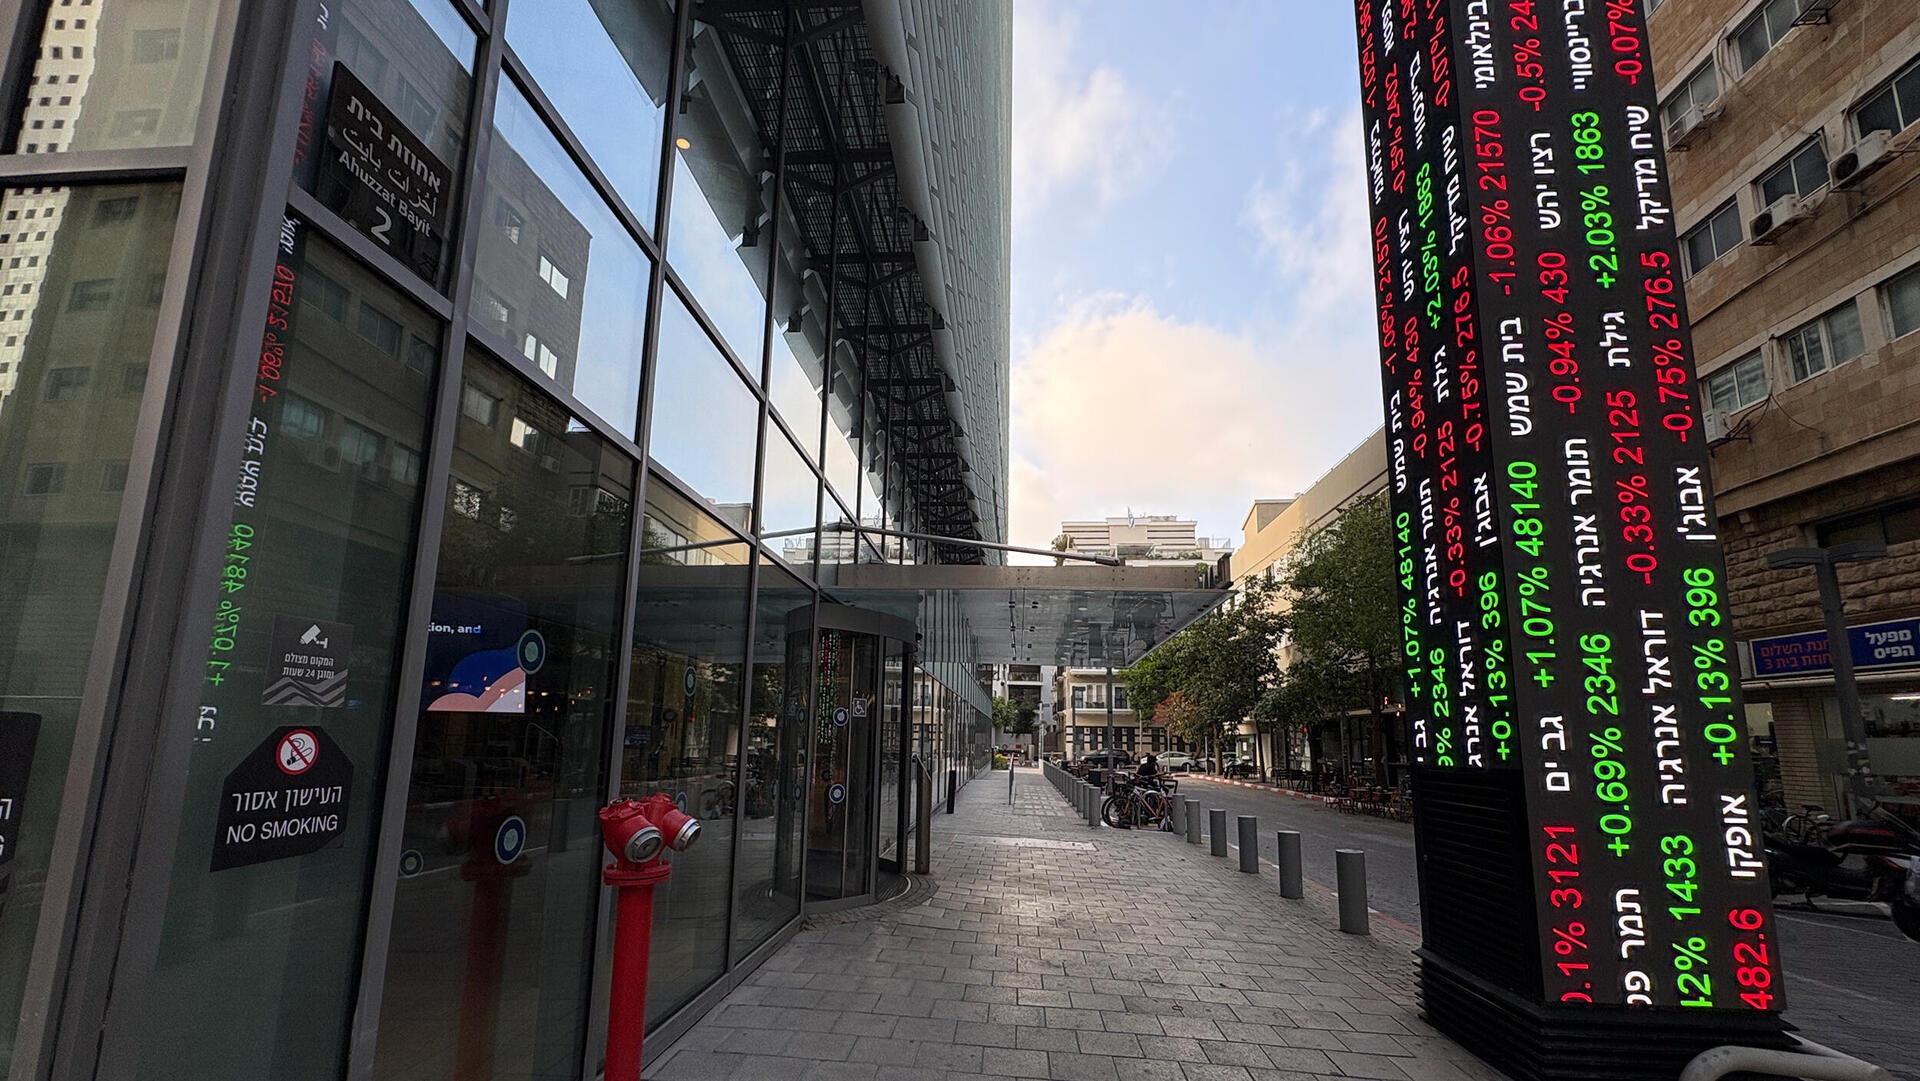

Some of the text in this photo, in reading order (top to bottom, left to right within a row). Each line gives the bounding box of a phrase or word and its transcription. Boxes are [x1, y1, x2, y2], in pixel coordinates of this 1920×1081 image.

[1429, 16, 1451, 108] -0.07%
[1465, 0, 1496, 89] בינלאומי
[1512, 38, 1547, 112] -0.5%
[1384, 63, 1401, 129] 2402
[346, 96, 441, 193] אחוזת בית
[1370, 119, 1385, 205] בינלאומי
[1389, 125, 1406, 194] -0.5%
[1441, 125, 1458, 175] שיח
[1472, 109, 1507, 191] 21570
[1529, 132, 1555, 175] רציו
[1571, 111, 1605, 175] 1863
[339, 151, 432, 237] Ahuzzat Bayit
[370, 206, 392, 246] 2
[1415, 162, 1434, 229] 1863
[1446, 173, 1467, 256] מדיקל
[1535, 184, 1561, 229] יהש
[1375, 216, 1392, 292] 21570
[1398, 208, 1411, 254] רציו
[1480, 199, 1516, 296] -1.06%
[1579, 185, 1619, 289] +2.03%
[1420, 230, 1442, 330] +2.03%
[1451, 265, 1474, 348] 276.5
[1537, 252, 1569, 305] 430
[1380, 292, 1397, 375] -1.06%
[1403, 316, 1420, 363] 430
[1499, 317, 1525, 363] בית
[1543, 312, 1582, 414] -0.94%
[1599, 311, 1631, 368] גילת
[1432, 344, 1450, 403] גילת
[1458, 350, 1483, 452] -0.75%
[1505, 371, 1533, 436] שמש
[1389, 389, 1403, 434] בית
[1407, 368, 1427, 459] -0.94%
[1606, 390, 1644, 465] 2125
[1393, 438, 1407, 494] שמש
[1437, 420, 1458, 492] 2125
[1564, 438, 1593, 506] תומר
[1419, 477, 1434, 540] תומר
[1507, 461, 1544, 557] 48140
[1605, 0, 1774, 1010] -0.07% שיח מדיקל -0.75% 276.5 אבוג'ן +0.13% 396 אופקו 482.6
[1615, 475, 1658, 585] -0.33%
[1396, 512, 1414, 591] 48140
[1442, 497, 1466, 597] -0.33%
[1572, 514, 1606, 606] אנרגיה
[1424, 543, 1442, 626] אנרגיה
[1478, 571, 1501, 630] 396
[284, 653, 335, 667] המקום מצולם
[457, 625, 481, 634] and
[1402, 598, 1422, 698] +1.07%
[1456, 620, 1476, 697] דוראל
[1517, 566, 1556, 688] +1.07%
[1639, 609, 1673, 694] דוראל
[1775, 656, 1798, 669] בית
[1801, 652, 1832, 666] חוזת
[1865, 629, 1913, 645] מפעל
[1873, 644, 1916, 660] הפיס
[282, 667, 304, 677] שעות
[305, 668, 315, 678] 24
[1429, 647, 1450, 718] 2346
[1484, 639, 1512, 761] +0.13%
[1579, 634, 1619, 716] 2346
[1414, 719, 1427, 748] גב
[1539, 715, 1566, 751] גב
[1651, 704, 1687, 805] אנרגיה
[232, 786, 343, 813] העישון אסור
[1544, 762, 1571, 792] ים
[1589, 727, 1632, 857] +0.69%
[226, 814, 338, 845] NO SMOKING
[1543, 826, 1583, 909] 3121
[1660, 834, 1701, 921] 1433
[1615, 888, 1646, 959] תמר
